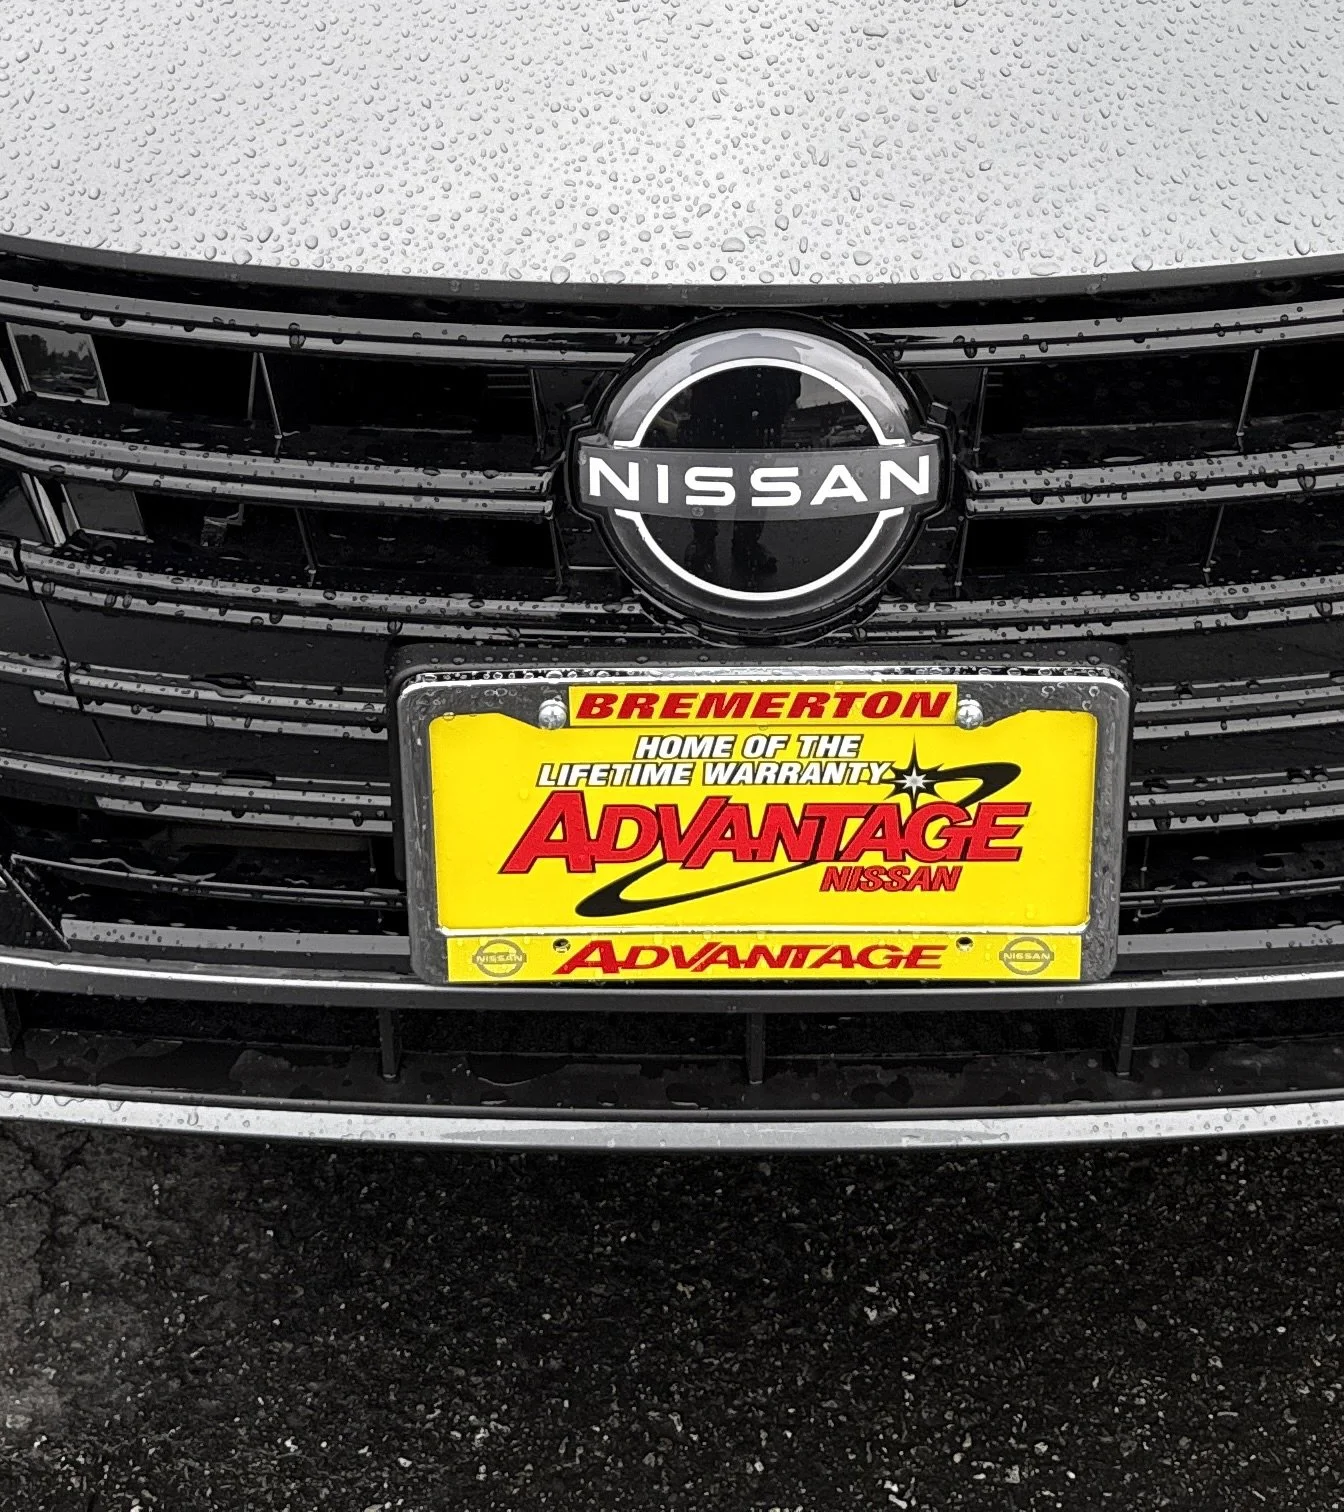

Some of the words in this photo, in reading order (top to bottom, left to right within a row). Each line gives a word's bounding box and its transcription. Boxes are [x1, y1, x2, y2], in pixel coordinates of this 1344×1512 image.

[587, 454, 931, 508] NISSAN
[573, 690, 954, 722] BREMERTON
[633, 734, 735, 760] HOME
[741, 734, 792, 759] OF
[797, 733, 865, 758] THE
[534, 761, 698, 788] LIFETIME
[702, 760, 895, 787] WARRANTY
[497, 789, 1032, 875] ADVANTAGE
[818, 864, 964, 893] NISSAN
[475, 954, 523, 963] NISSAN
[551, 939, 949, 976] ADVANTAGE
[1002, 952, 1050, 961] NISSAN
